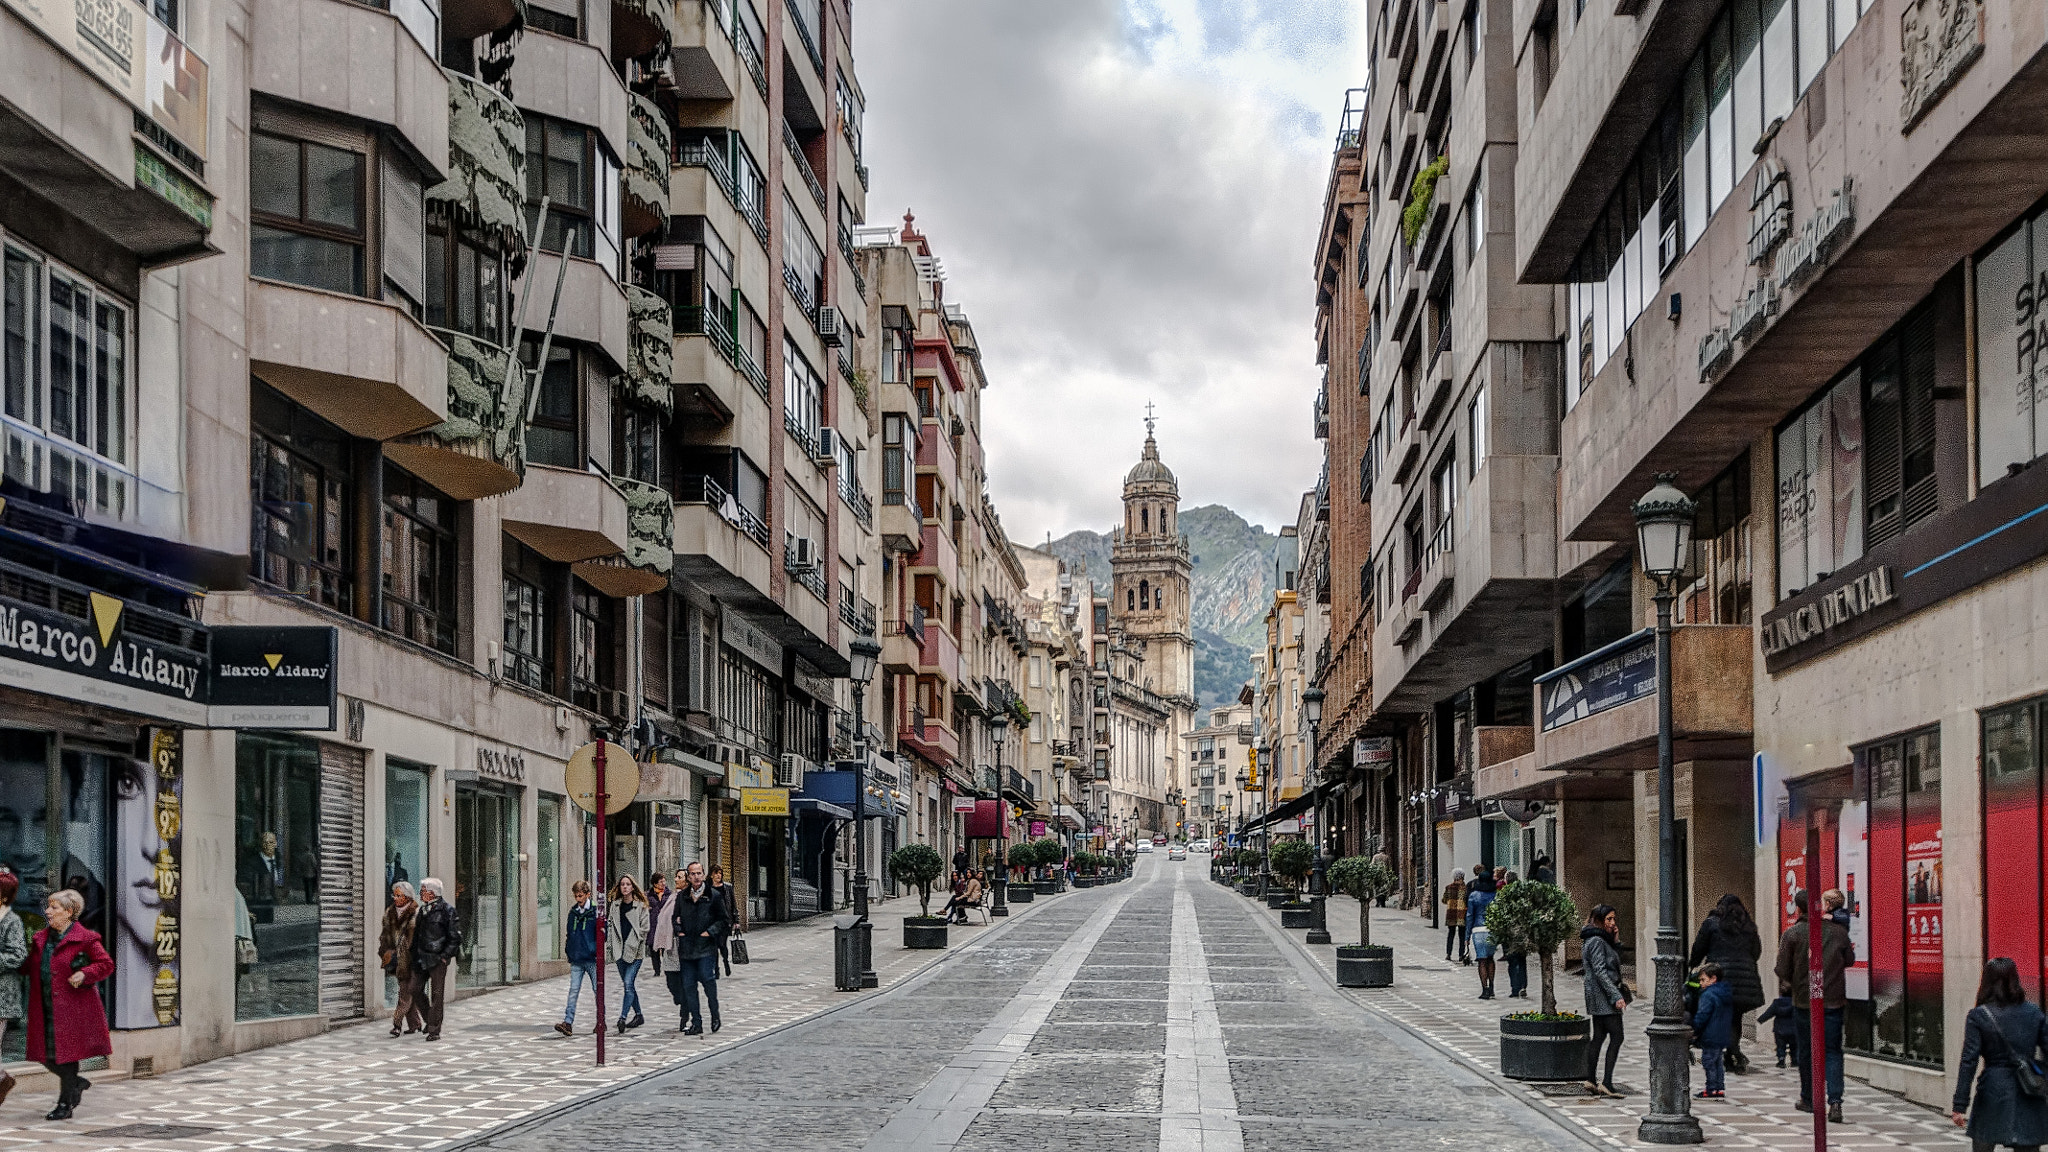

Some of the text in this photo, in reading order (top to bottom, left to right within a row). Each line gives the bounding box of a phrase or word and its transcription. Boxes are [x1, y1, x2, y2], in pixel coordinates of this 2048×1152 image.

[0, 604, 199, 699] Marco Aldany
[220, 664, 327, 679] Marco Aldany
